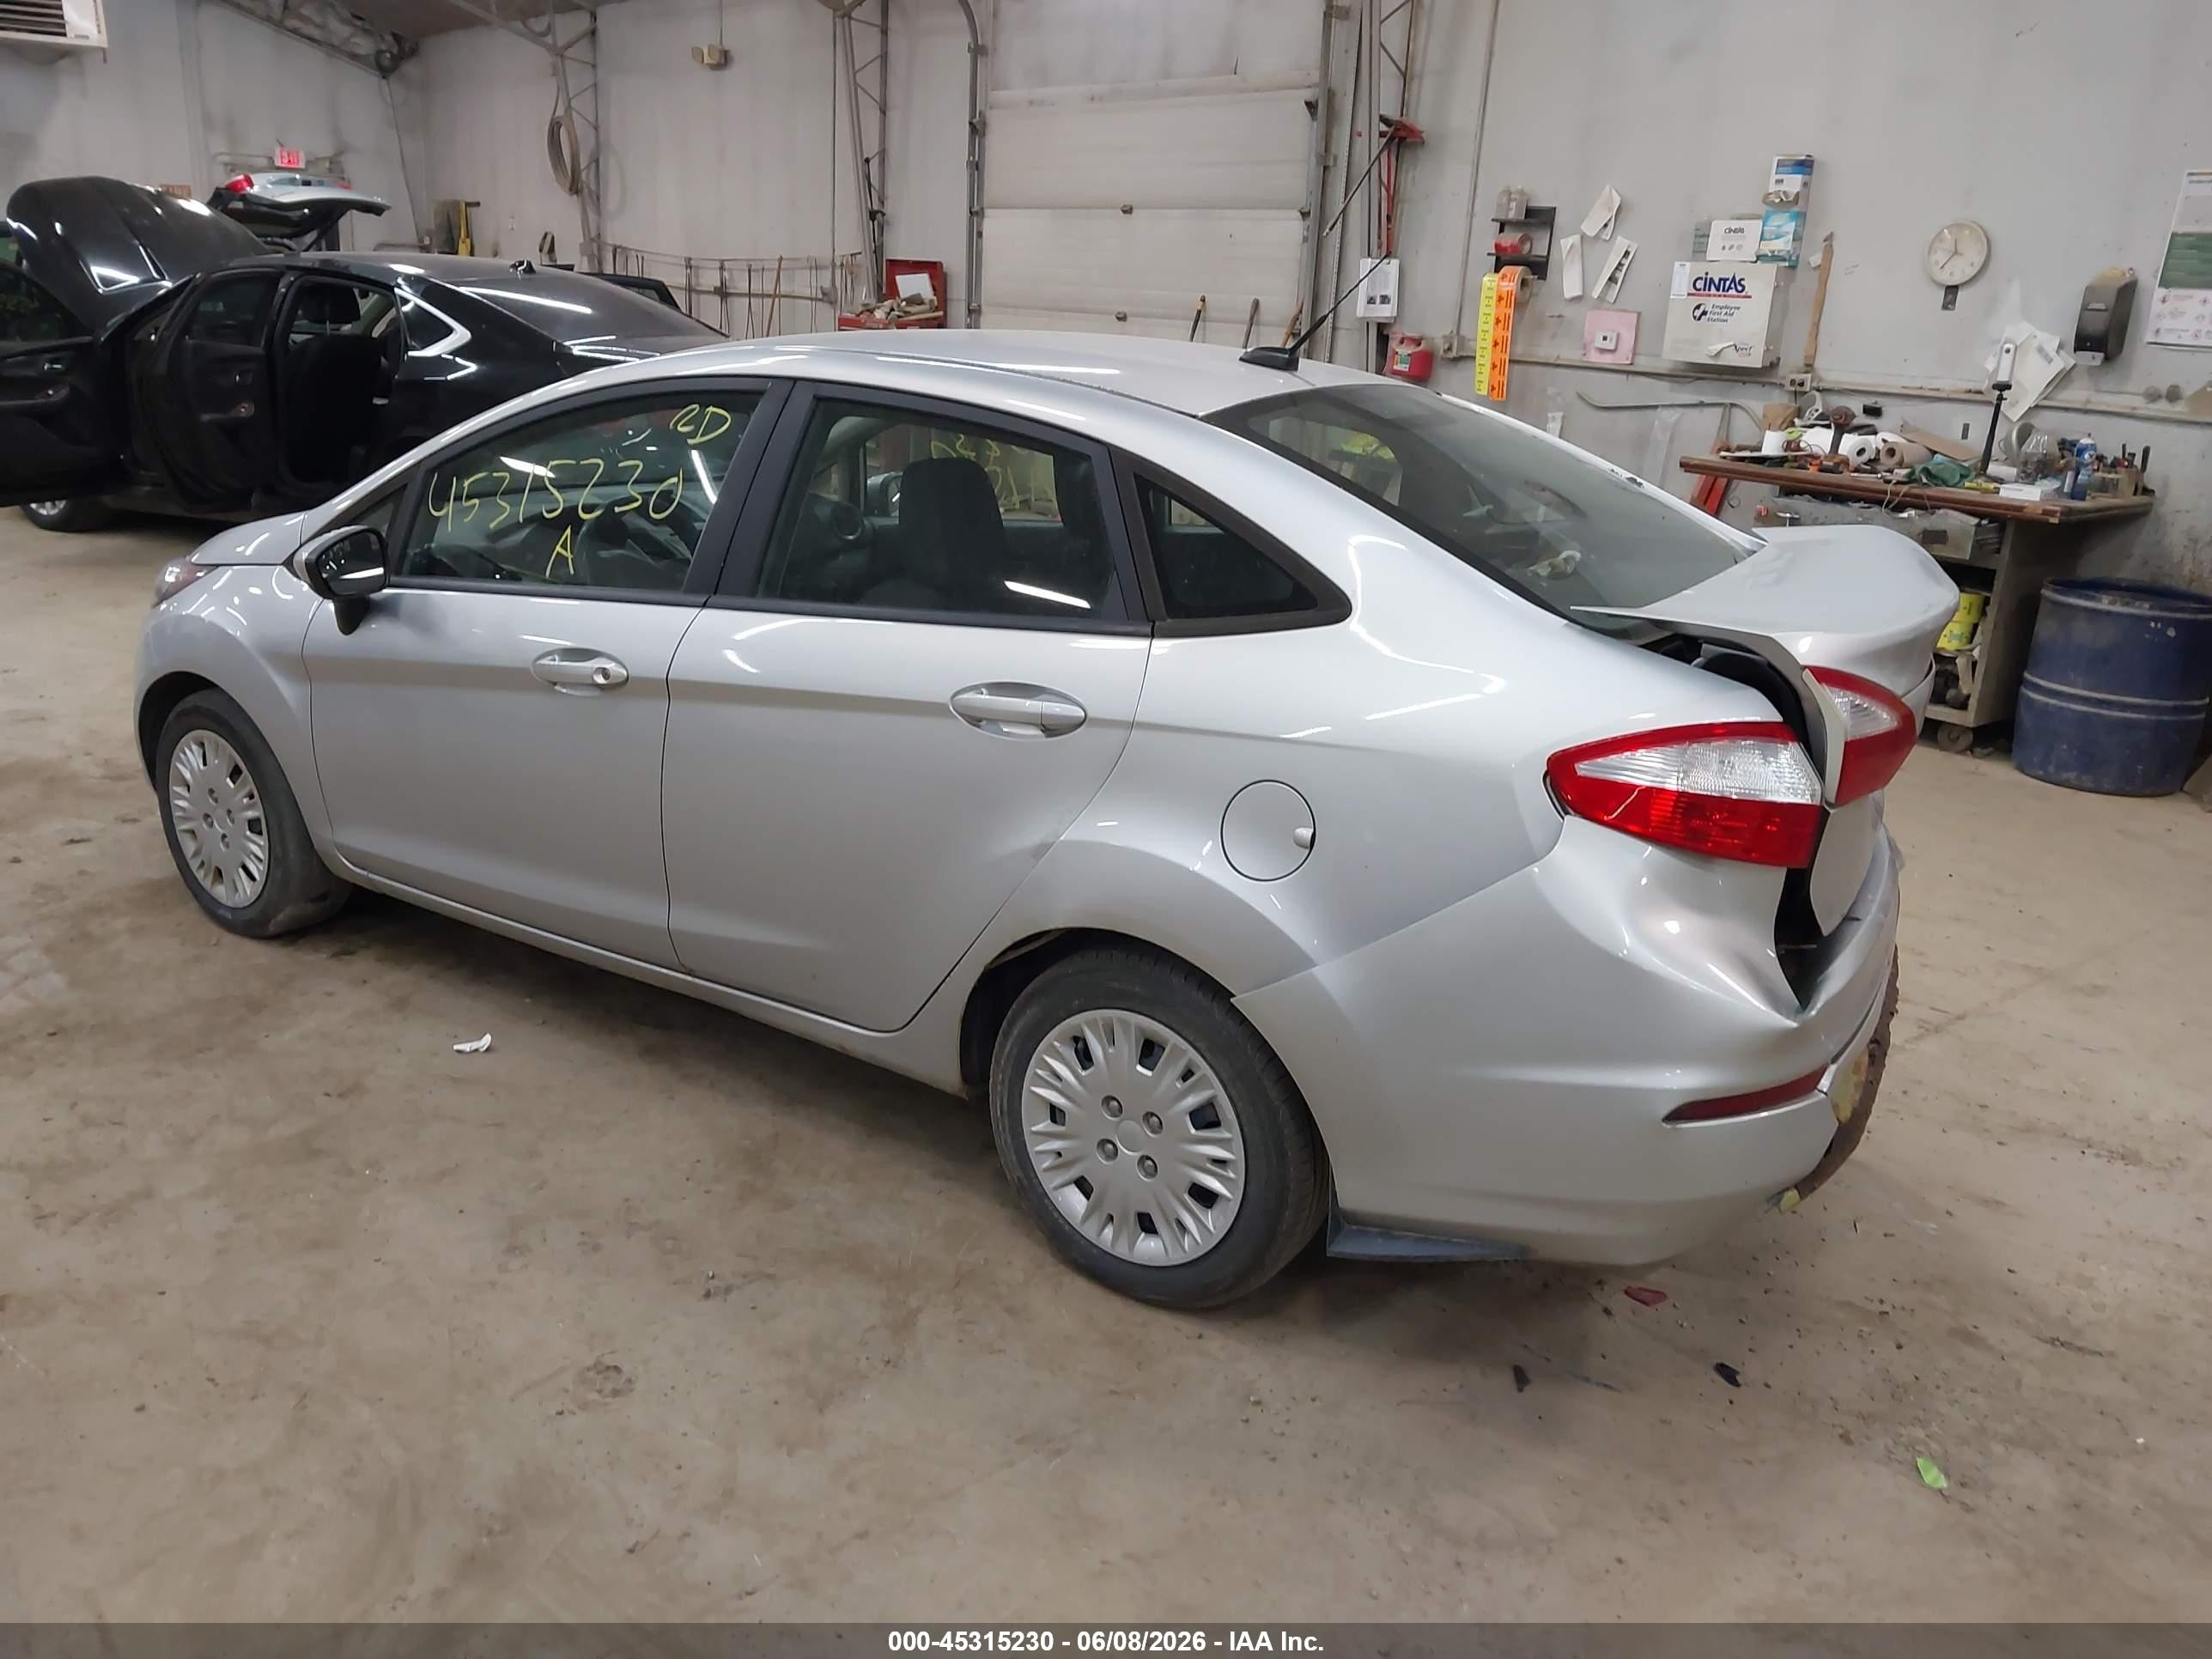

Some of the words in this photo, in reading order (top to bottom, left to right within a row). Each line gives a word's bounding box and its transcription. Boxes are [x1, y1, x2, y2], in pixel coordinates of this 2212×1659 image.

[280, 149, 300, 166] EXIT
[1692, 271, 1747, 294] CINTAS
[1711, 303, 1741, 312] Employee
[428, 458, 683, 532] 45315230
[545, 525, 575, 578] A
